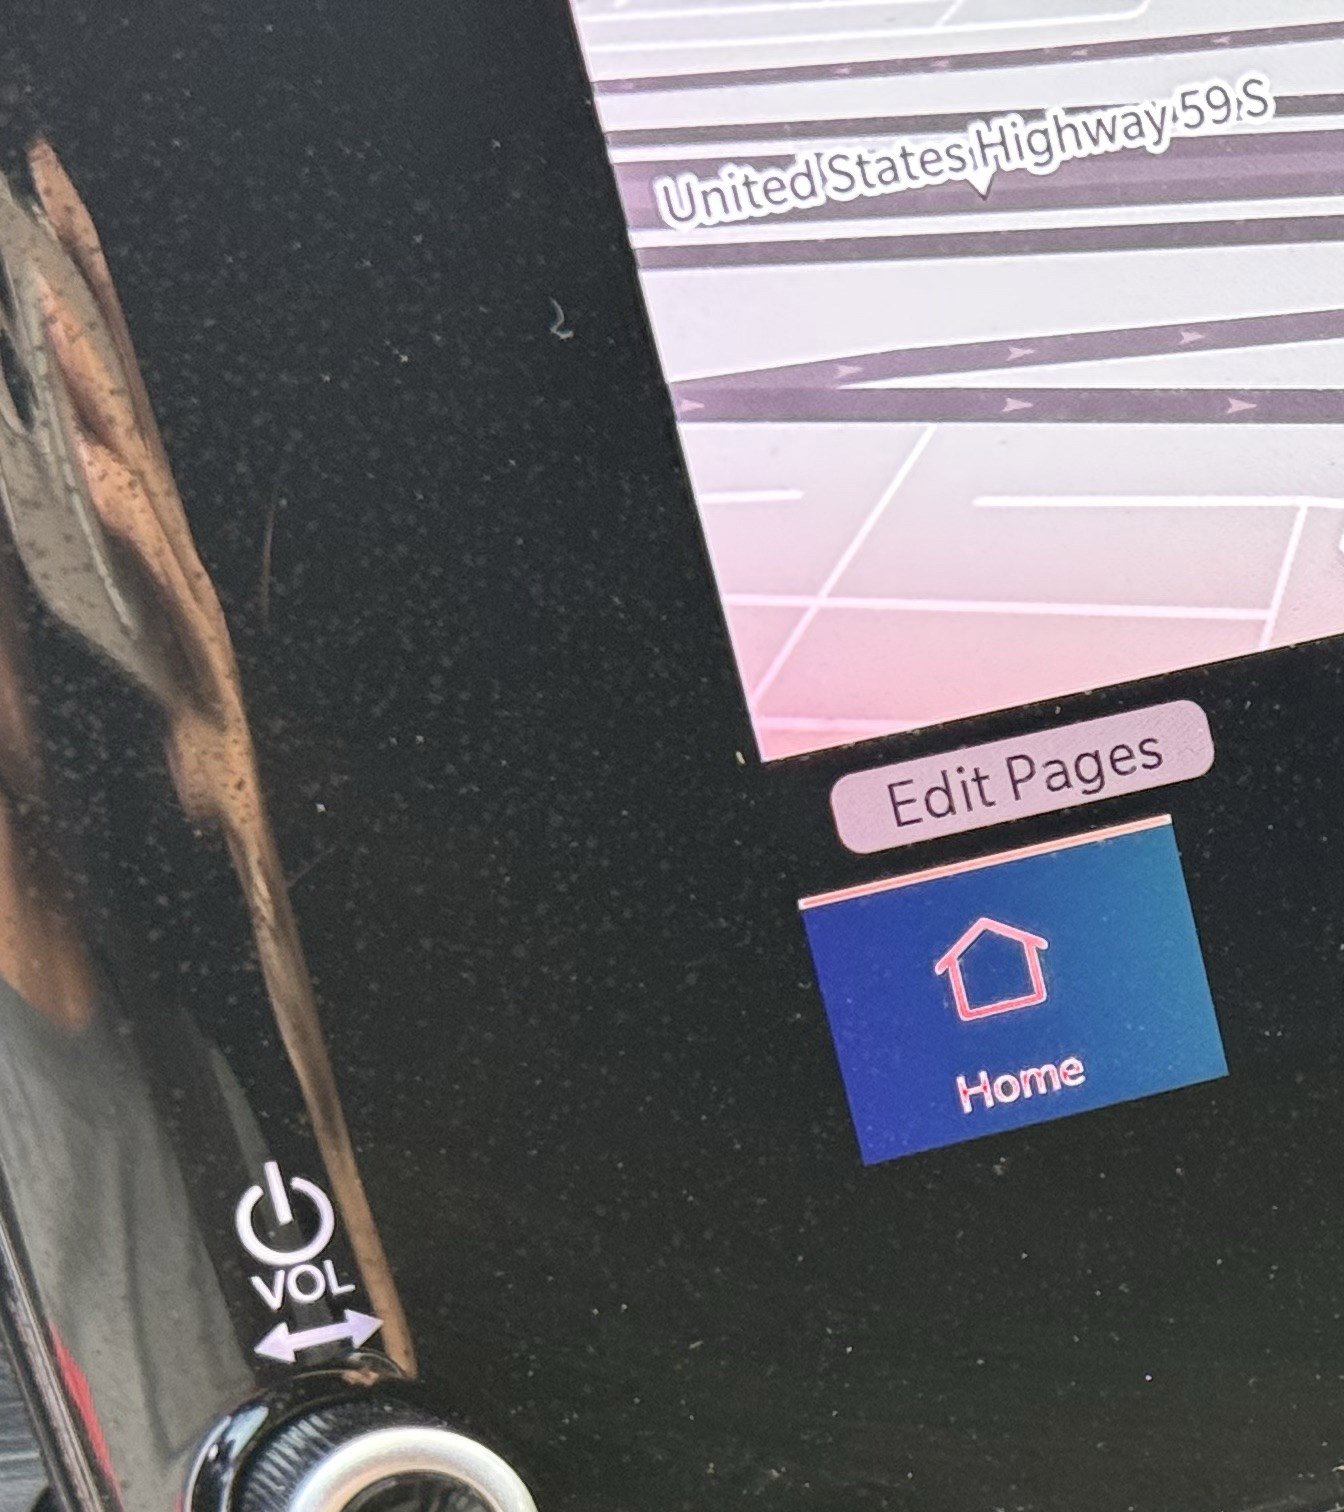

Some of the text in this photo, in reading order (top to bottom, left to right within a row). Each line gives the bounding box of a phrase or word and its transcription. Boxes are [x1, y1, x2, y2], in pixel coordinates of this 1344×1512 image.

[660, 77, 1272, 219] United States Highway 59 S
[886, 735, 1165, 828] Edit Pages
[954, 1055, 1087, 1115] Home
[249, 1258, 356, 1312] VOL
